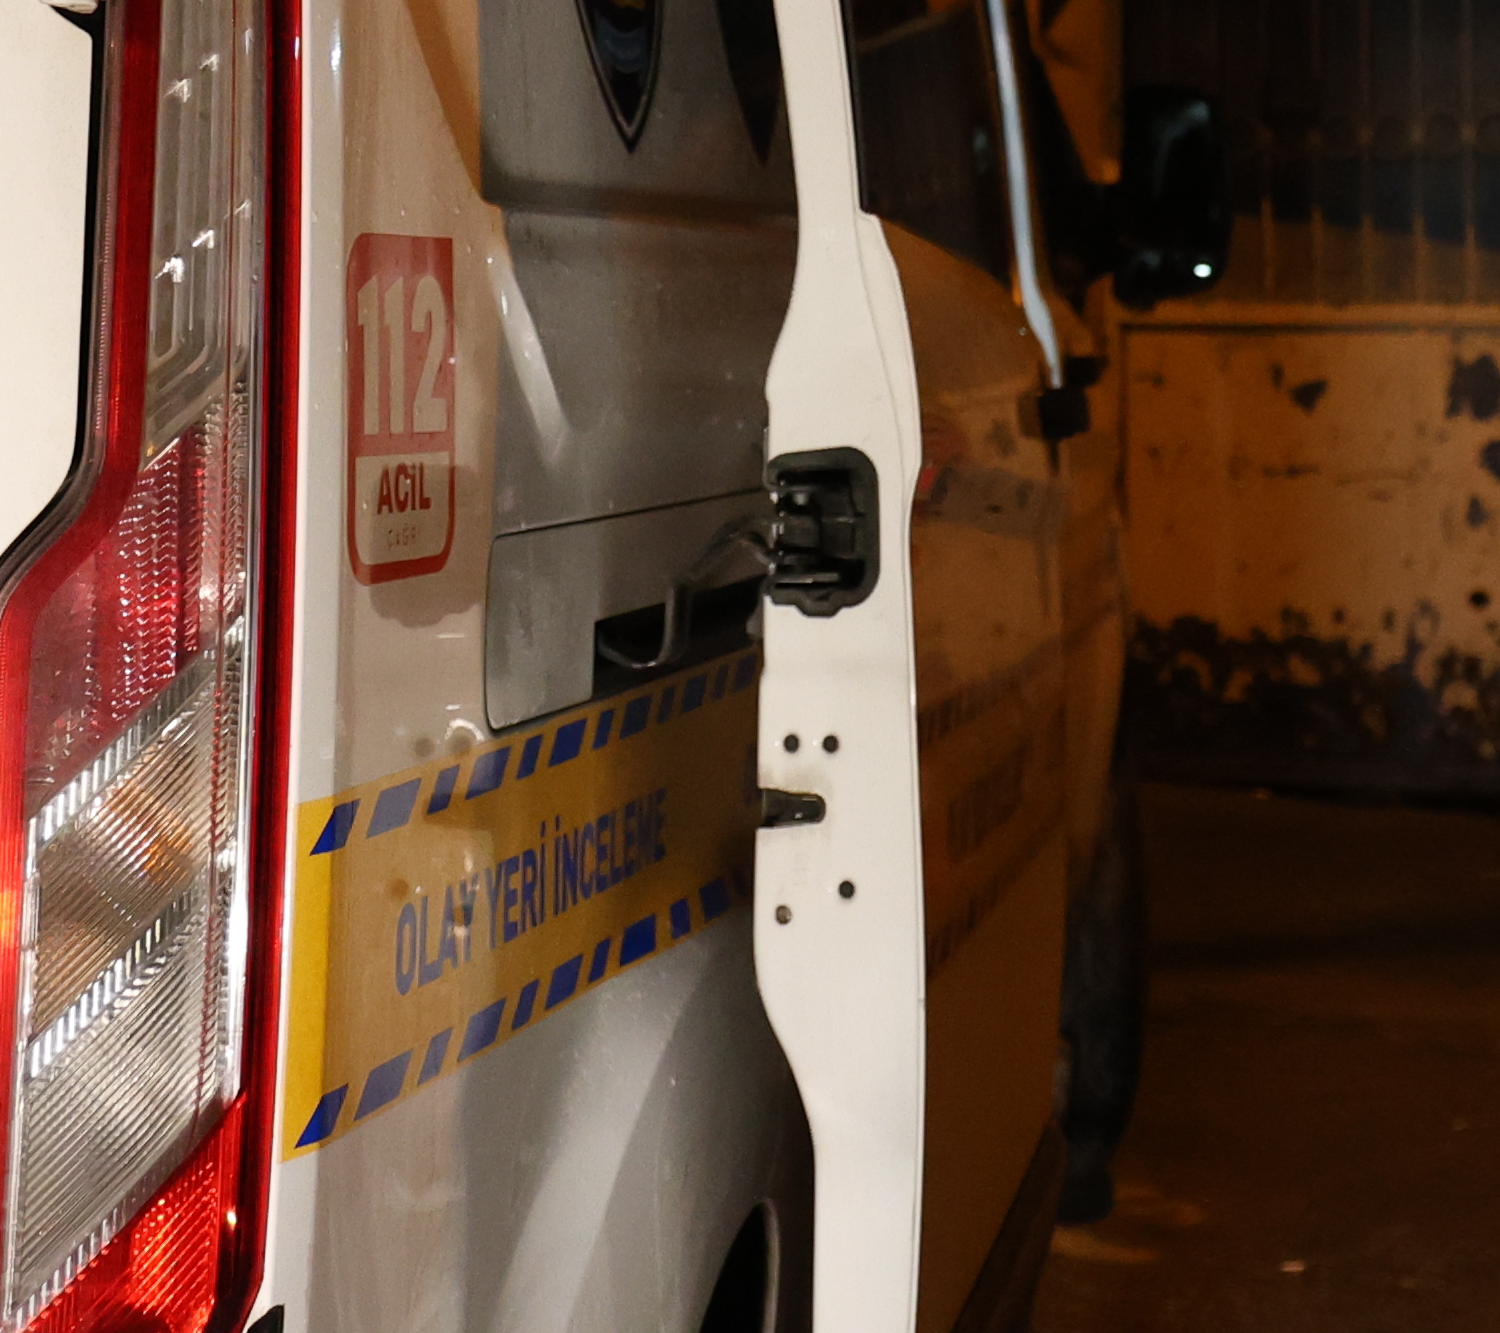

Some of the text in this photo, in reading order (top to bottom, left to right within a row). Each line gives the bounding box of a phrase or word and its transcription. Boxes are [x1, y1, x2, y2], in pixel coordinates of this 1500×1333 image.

[356, 274, 448, 435] 112
[395, 873, 480, 996] OLAY
[484, 821, 547, 952] YERİ
